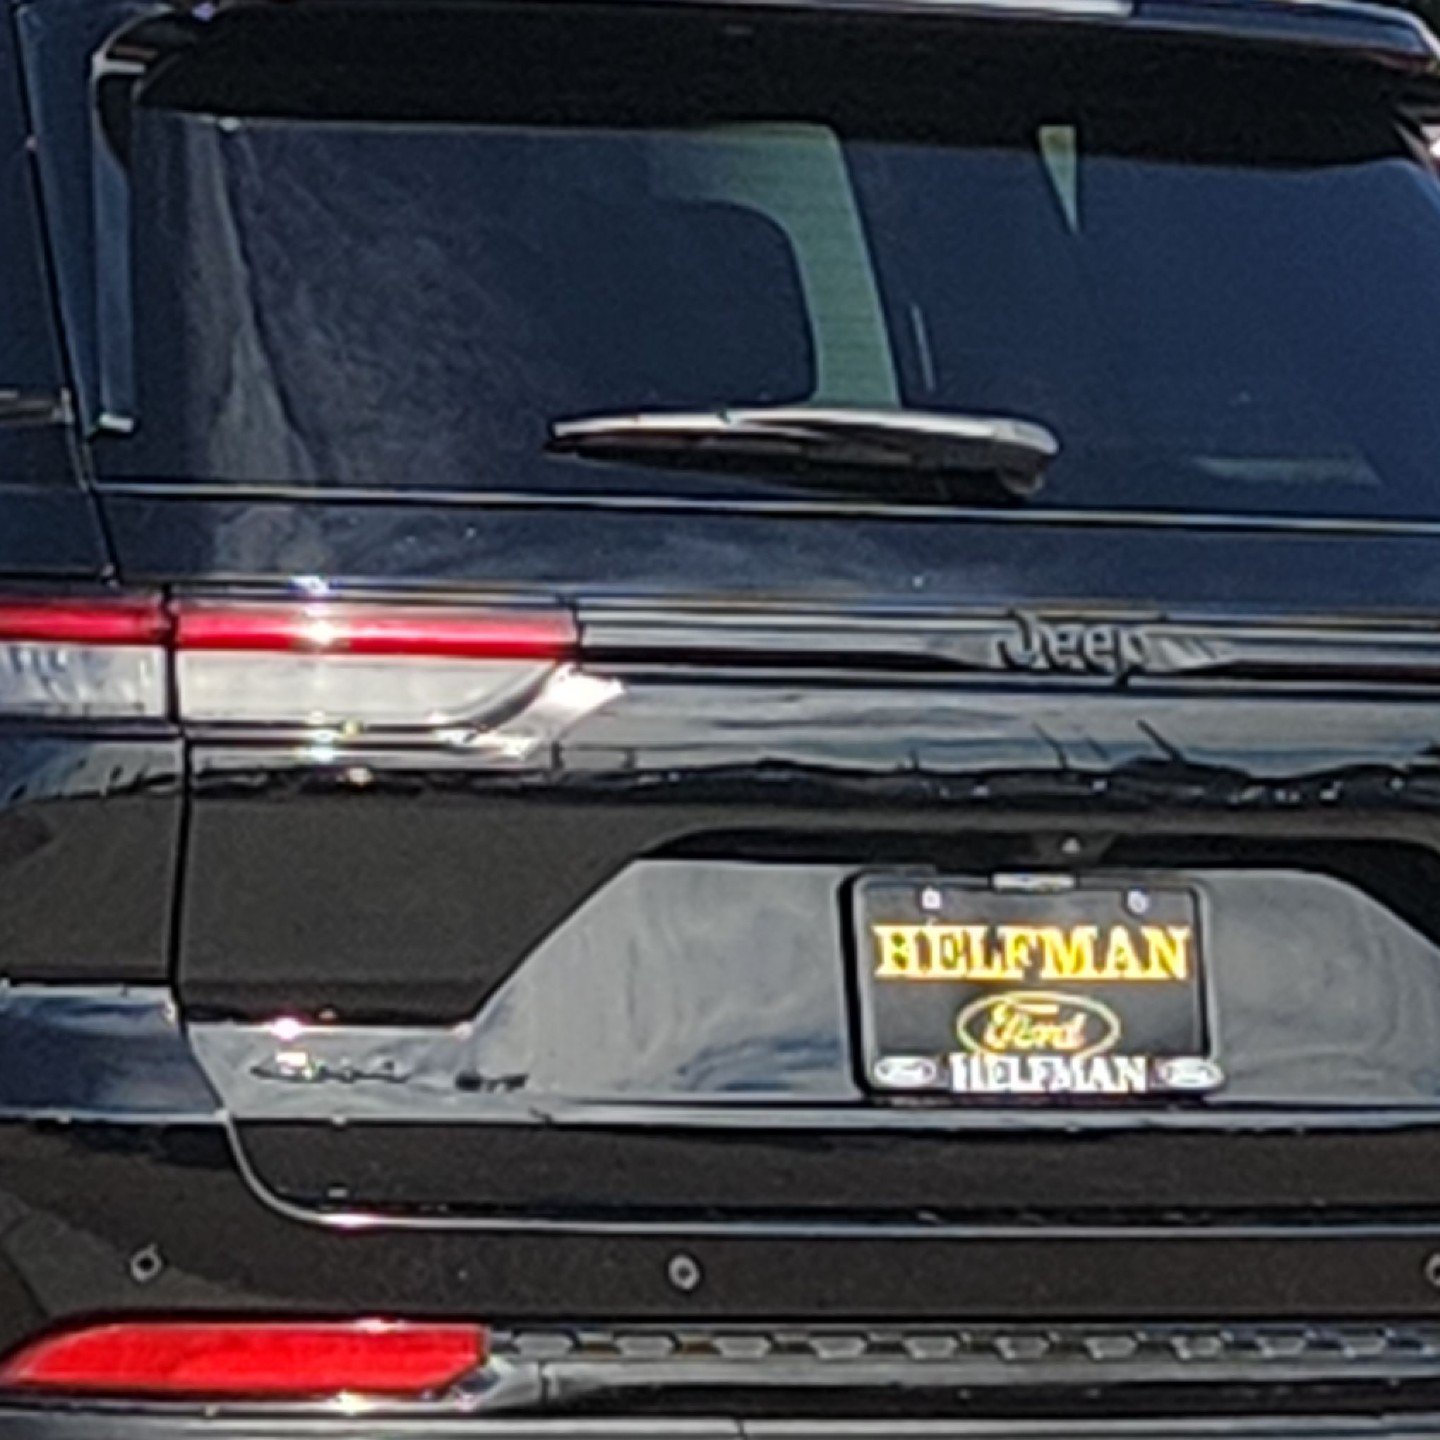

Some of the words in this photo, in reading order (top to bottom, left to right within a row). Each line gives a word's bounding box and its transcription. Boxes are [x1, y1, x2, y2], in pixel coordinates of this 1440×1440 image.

[997, 610, 1150, 688] Jeep
[872, 924, 1191, 981] HELFMAN
[984, 1002, 1089, 1051] Ford
[948, 1052, 1148, 1094] HELFMAN
